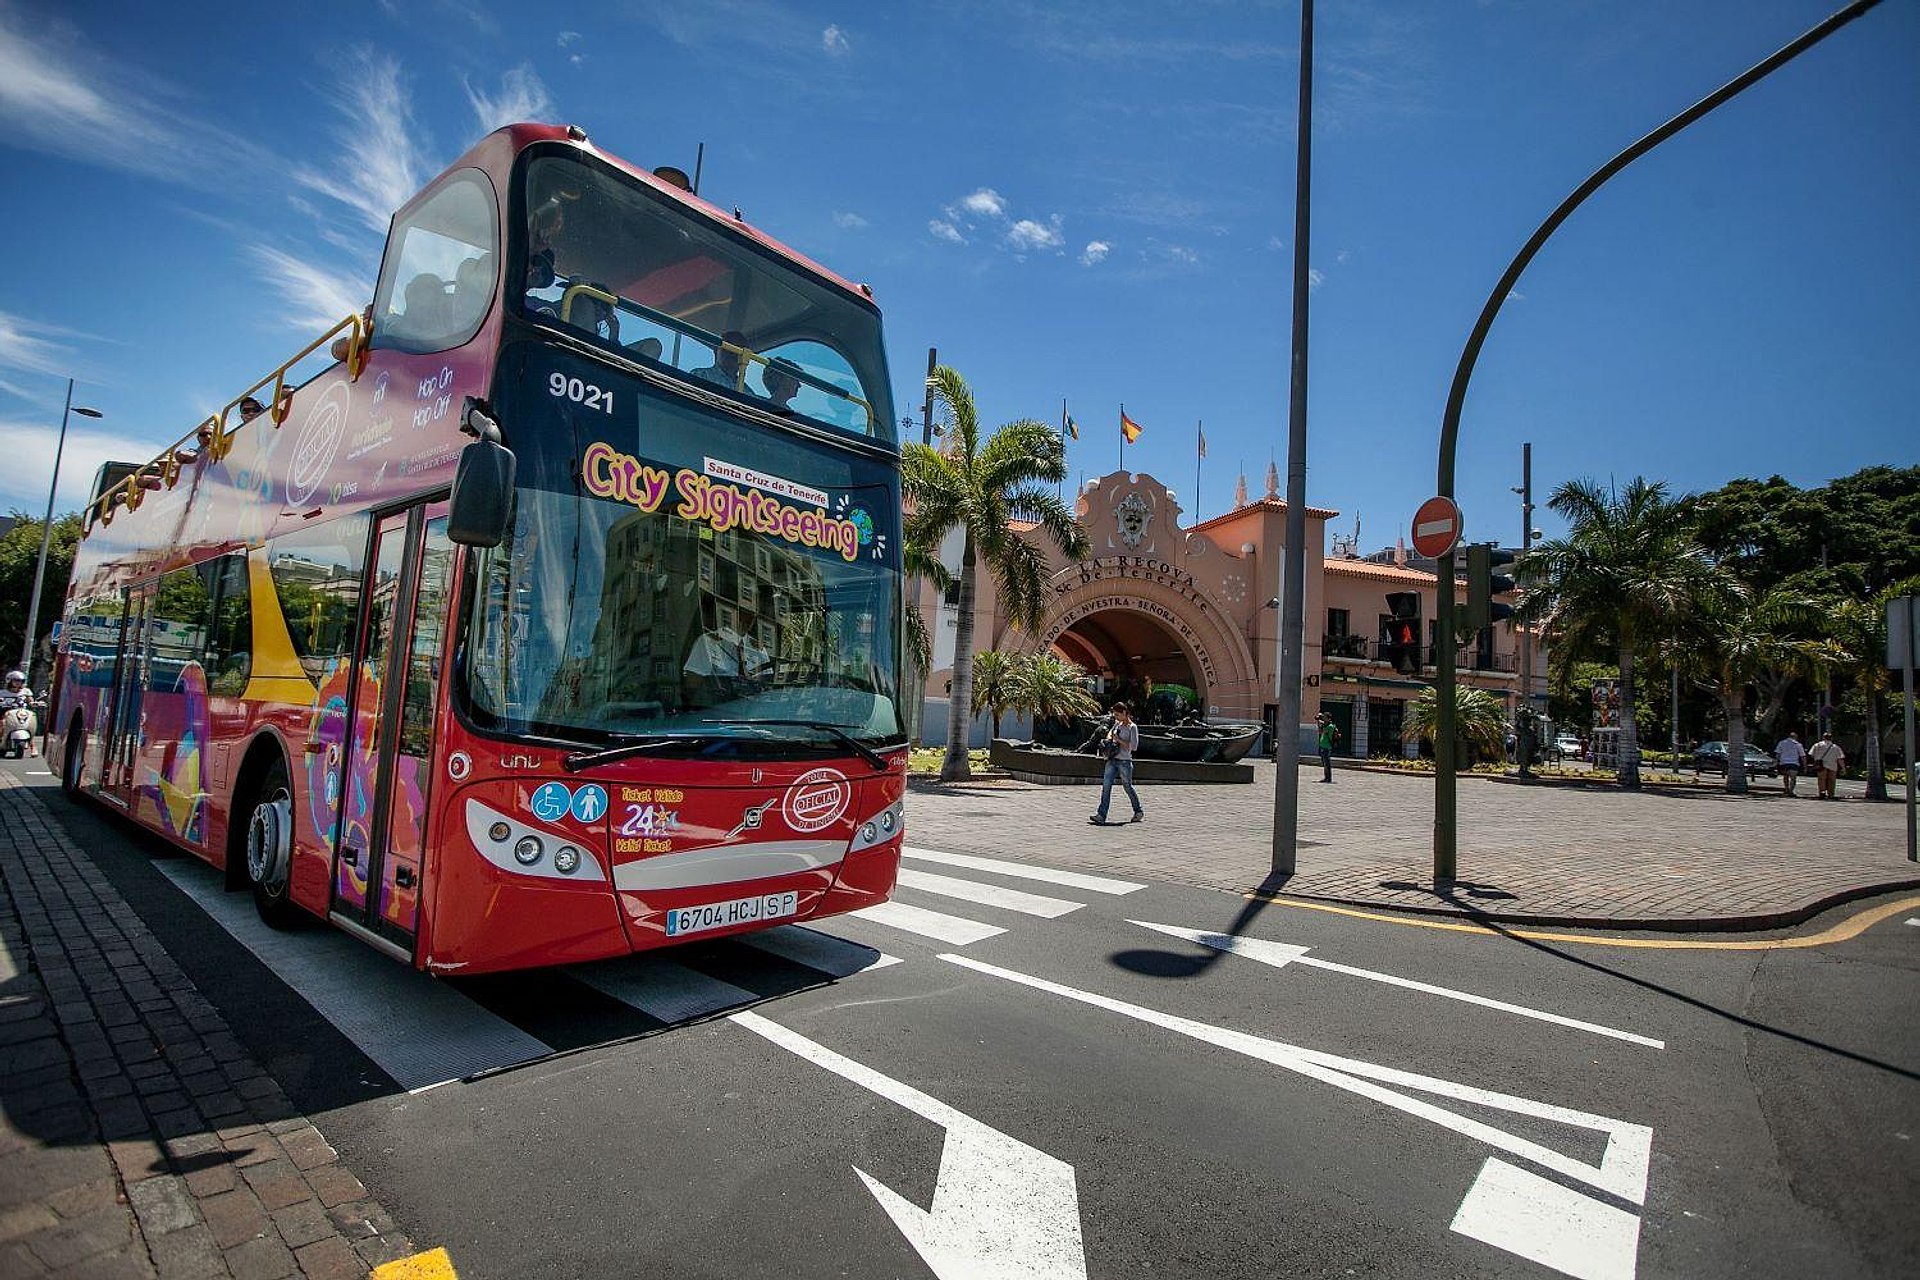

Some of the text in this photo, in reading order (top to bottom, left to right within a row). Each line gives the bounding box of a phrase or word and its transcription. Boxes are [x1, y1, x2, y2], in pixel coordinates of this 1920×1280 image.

[549, 372, 614, 415] 9021
[583, 442, 858, 561] City Sightseeing
[708, 461, 826, 505] Santa Cruz de Tenerife
[1079, 555, 1194, 587] LA RECOVA
[1080, 572, 1101, 584] De
[1118, 566, 1208, 615] Tenerife
[1063, 611, 1077, 625] DE
[1081, 597, 1130, 614] NVESTRA
[1180, 624, 1193, 640] DE
[796, 788, 838, 810] OFICIAL
[679, 900, 759, 931] 6704 HCJ
[767, 894, 794, 916] S P
